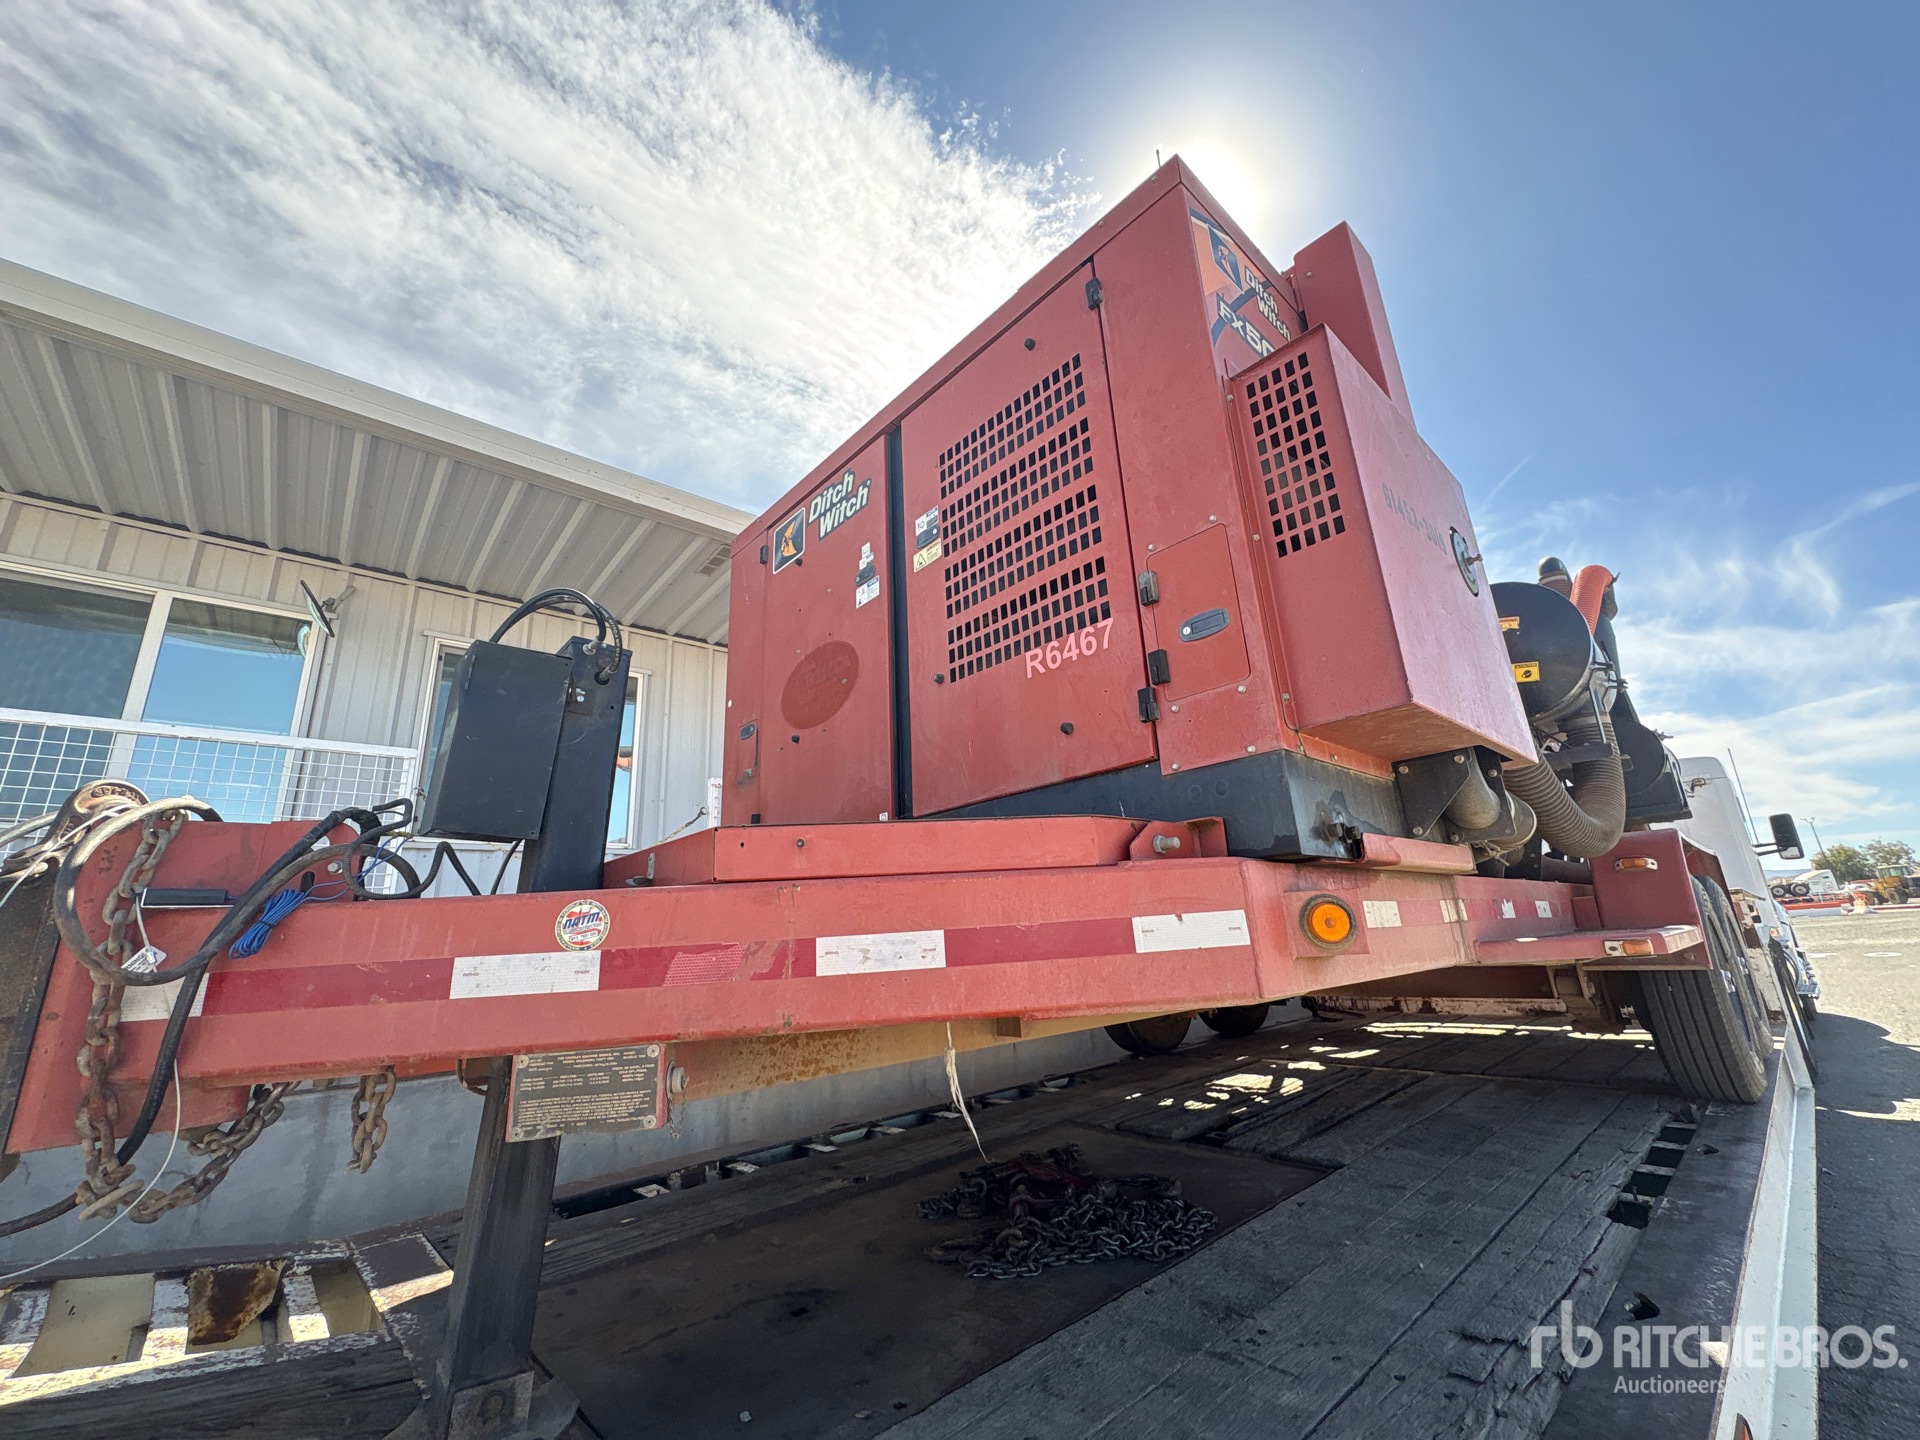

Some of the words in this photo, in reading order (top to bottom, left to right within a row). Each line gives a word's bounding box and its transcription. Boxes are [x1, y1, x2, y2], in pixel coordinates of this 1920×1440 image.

[1245, 266, 1278, 313] Ditch
[1256, 294, 1291, 342] Witch
[808, 471, 855, 524] Ditch
[818, 484, 869, 539] Witch
[1025, 617, 1114, 679] R6467
